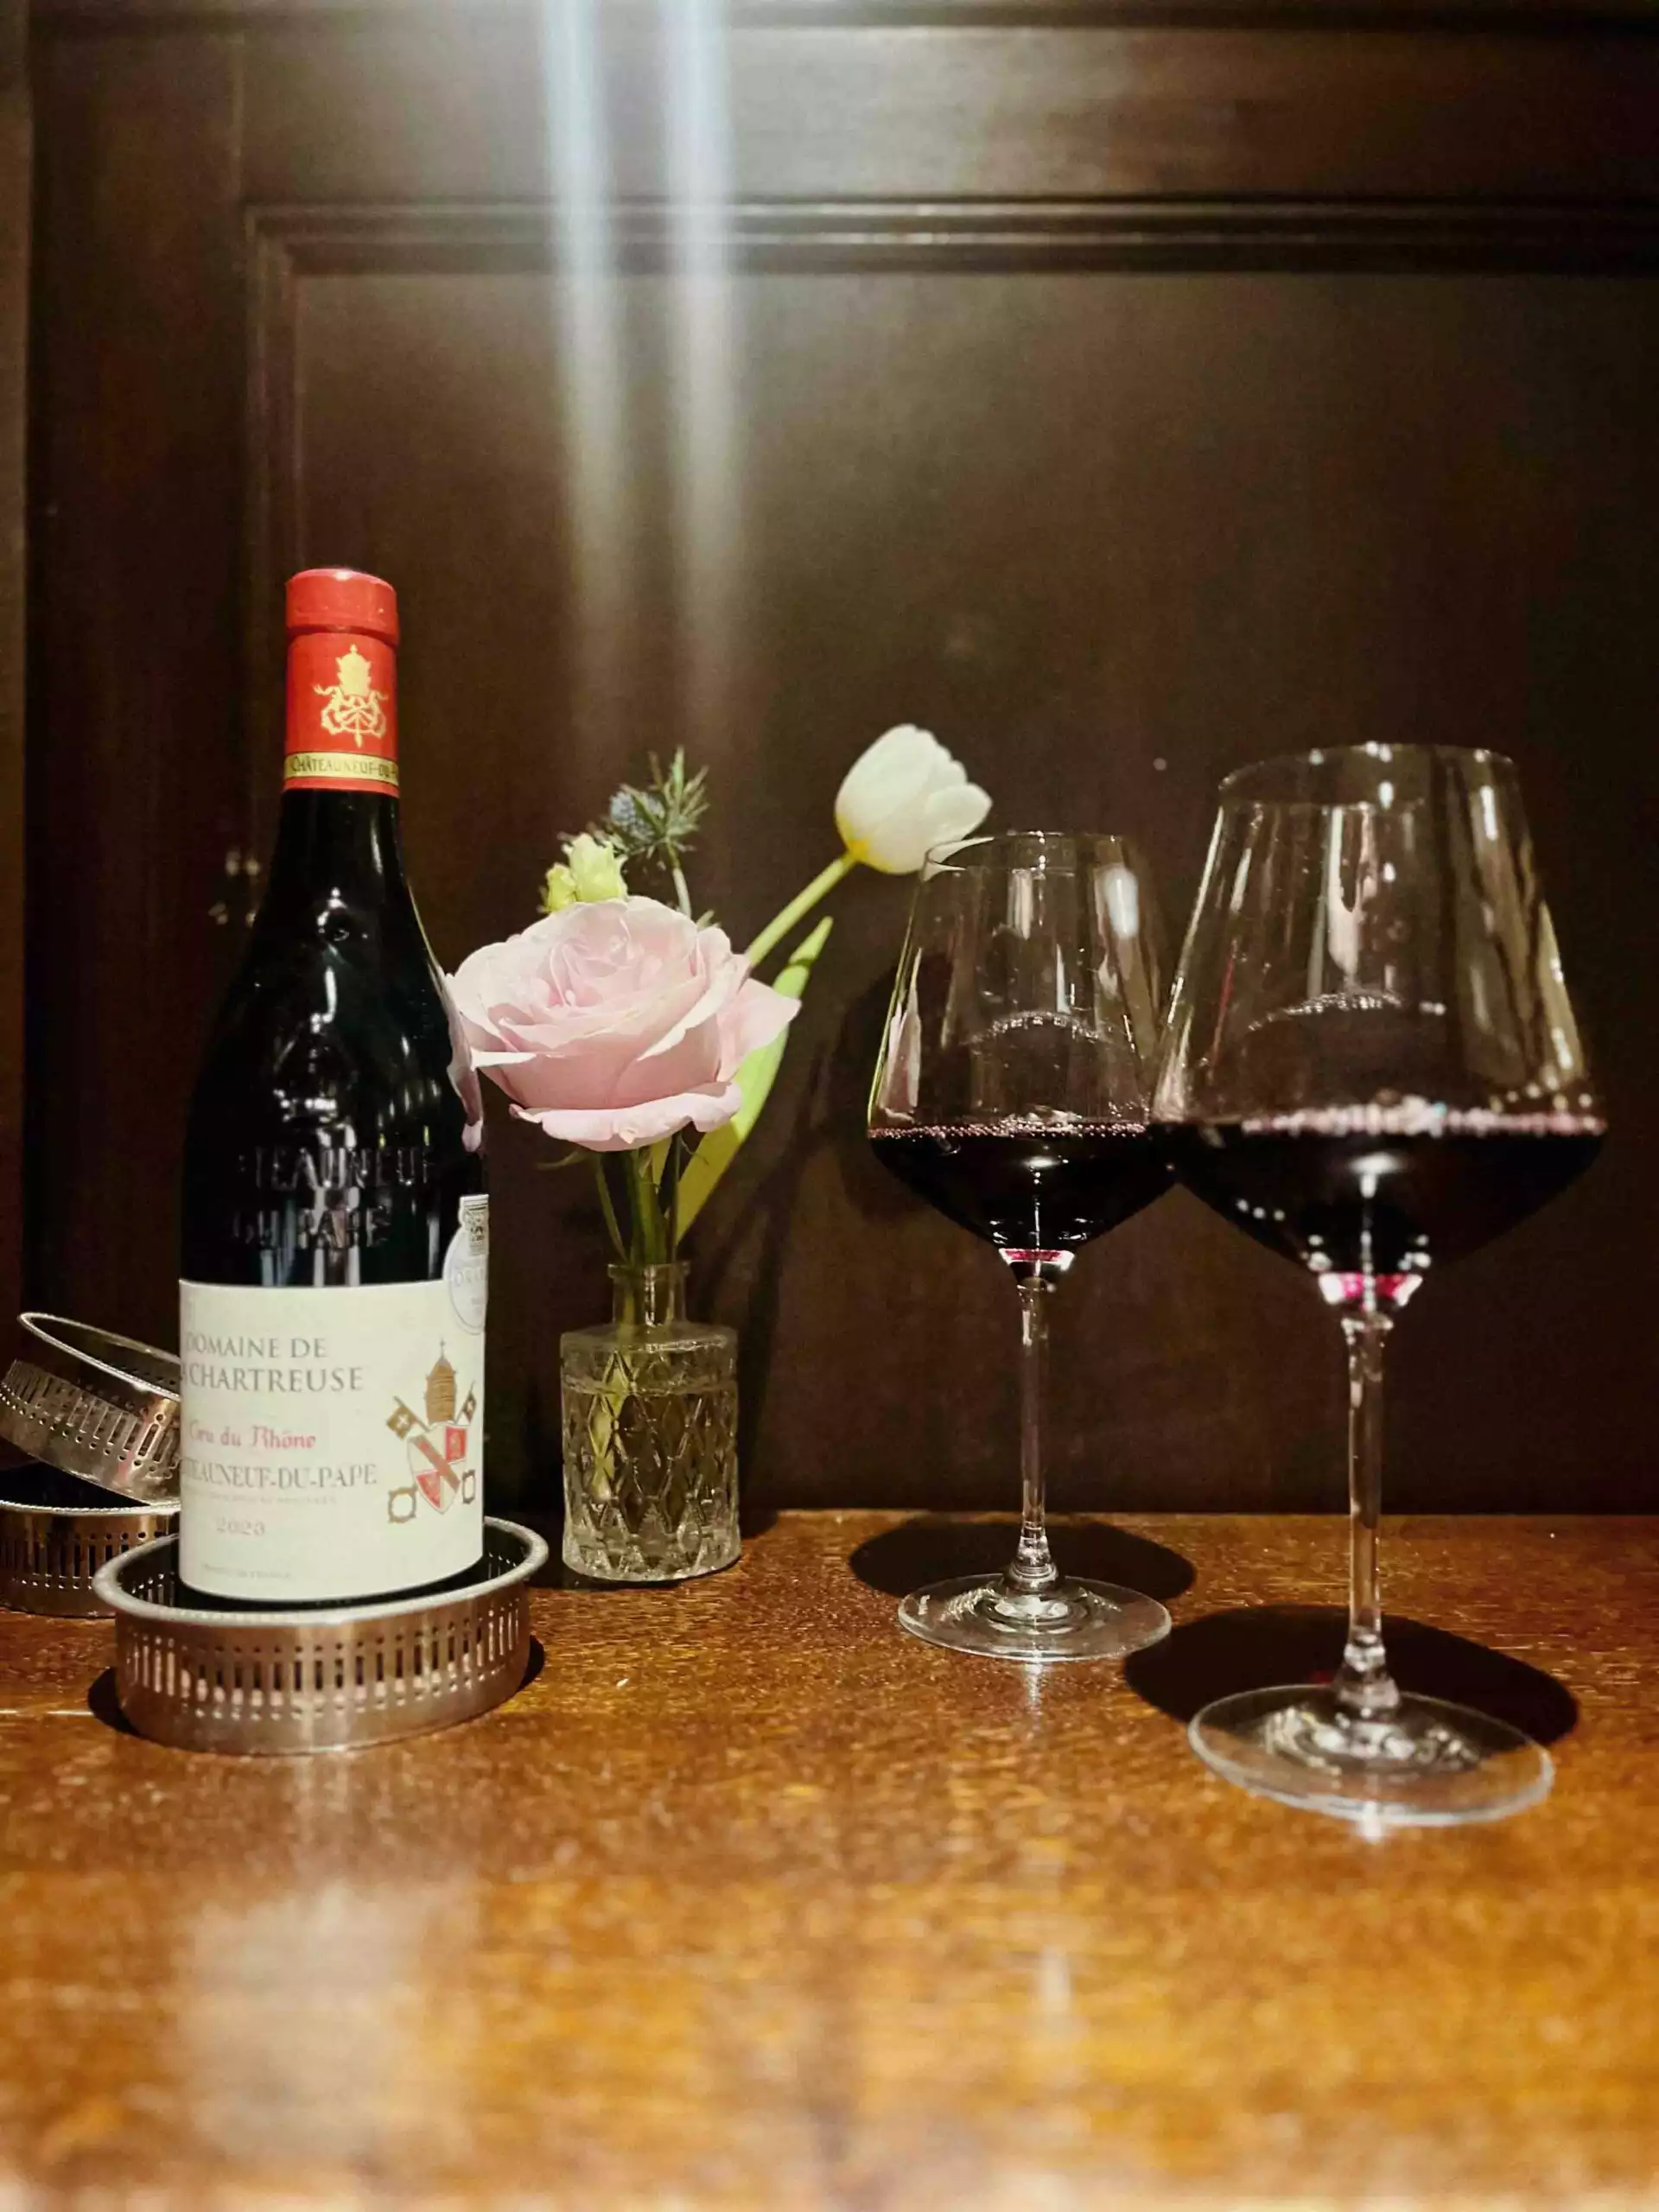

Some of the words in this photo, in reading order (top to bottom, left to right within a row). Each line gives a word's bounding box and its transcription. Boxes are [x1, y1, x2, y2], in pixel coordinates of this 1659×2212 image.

[185, 1332, 280, 1359] DOMAINE
[290, 1337, 328, 1359] DE
[188, 1363, 365, 1393] CHARTREUSE
[219, 1426, 242, 1447] du
